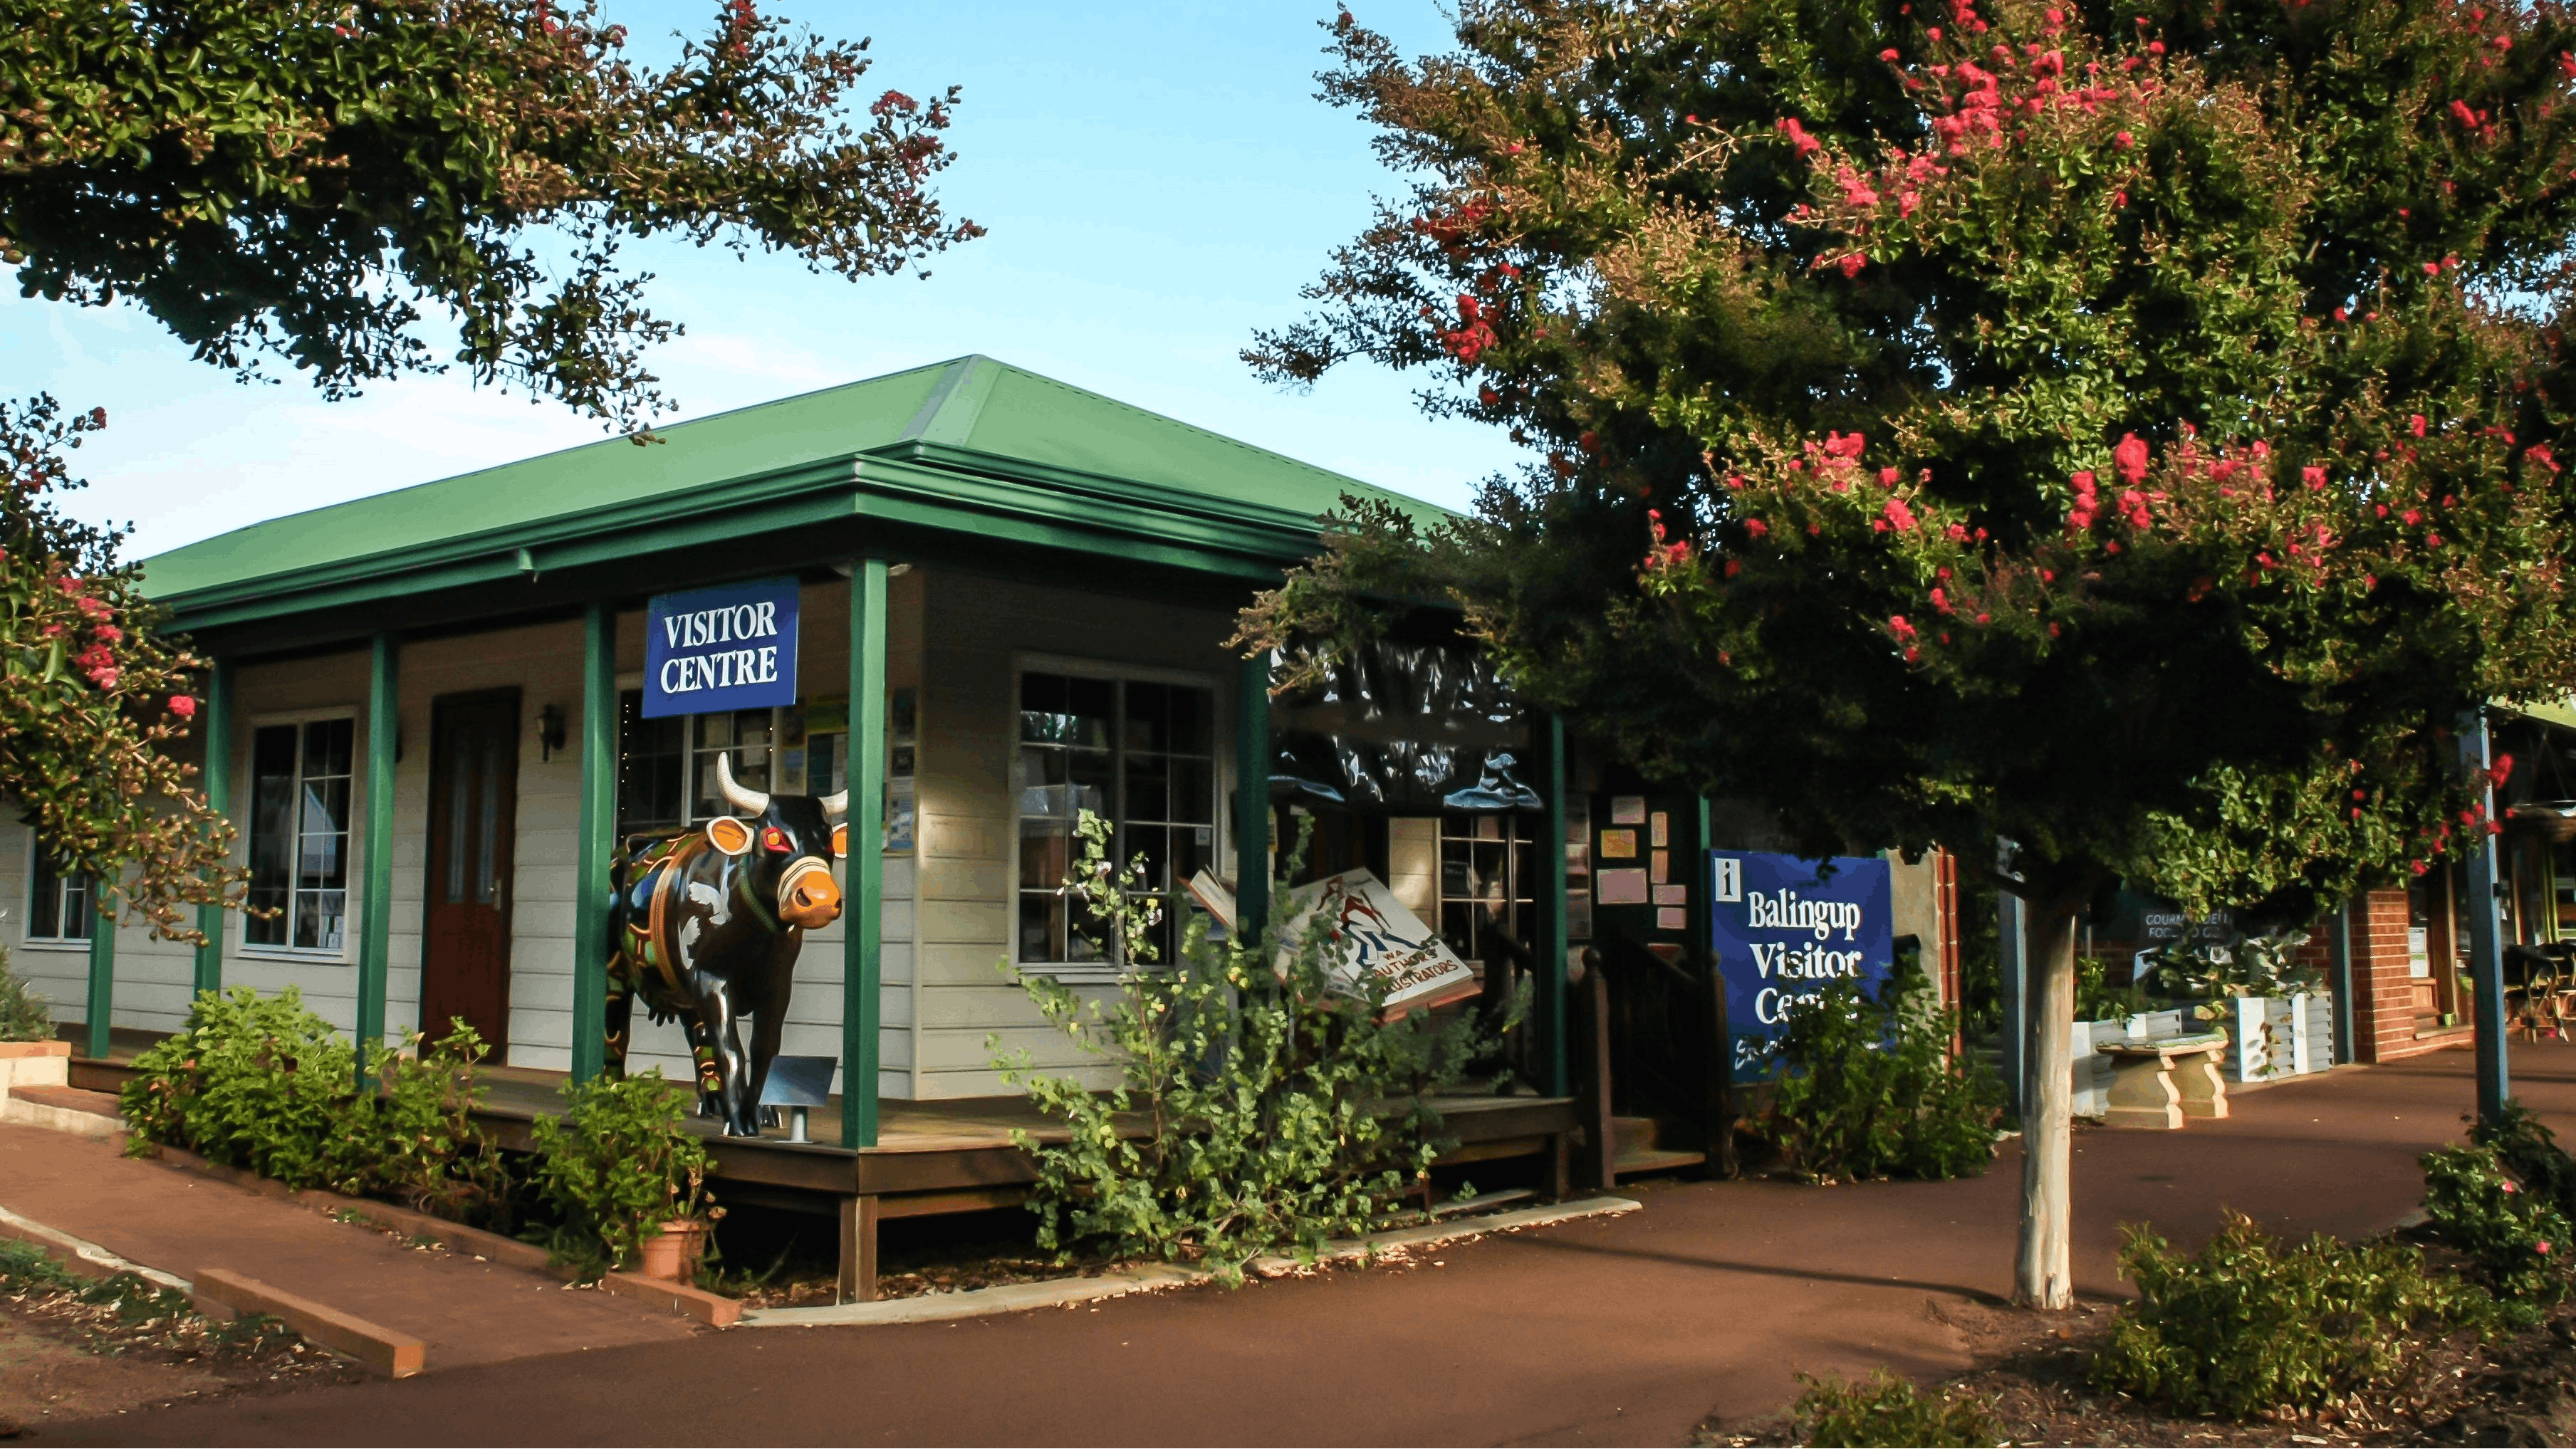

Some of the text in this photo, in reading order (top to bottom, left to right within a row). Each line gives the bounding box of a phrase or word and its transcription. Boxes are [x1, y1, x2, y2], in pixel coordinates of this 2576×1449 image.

[664, 602, 778, 649] VISITOR
[661, 646, 778, 694] CENTRE
[1724, 861, 1733, 896] i
[1748, 888, 1862, 941] Balingup
[1383, 950, 1404, 961] WA
[1749, 941, 1863, 979] Visitor
[1383, 958, 1459, 992] USTRATORS
